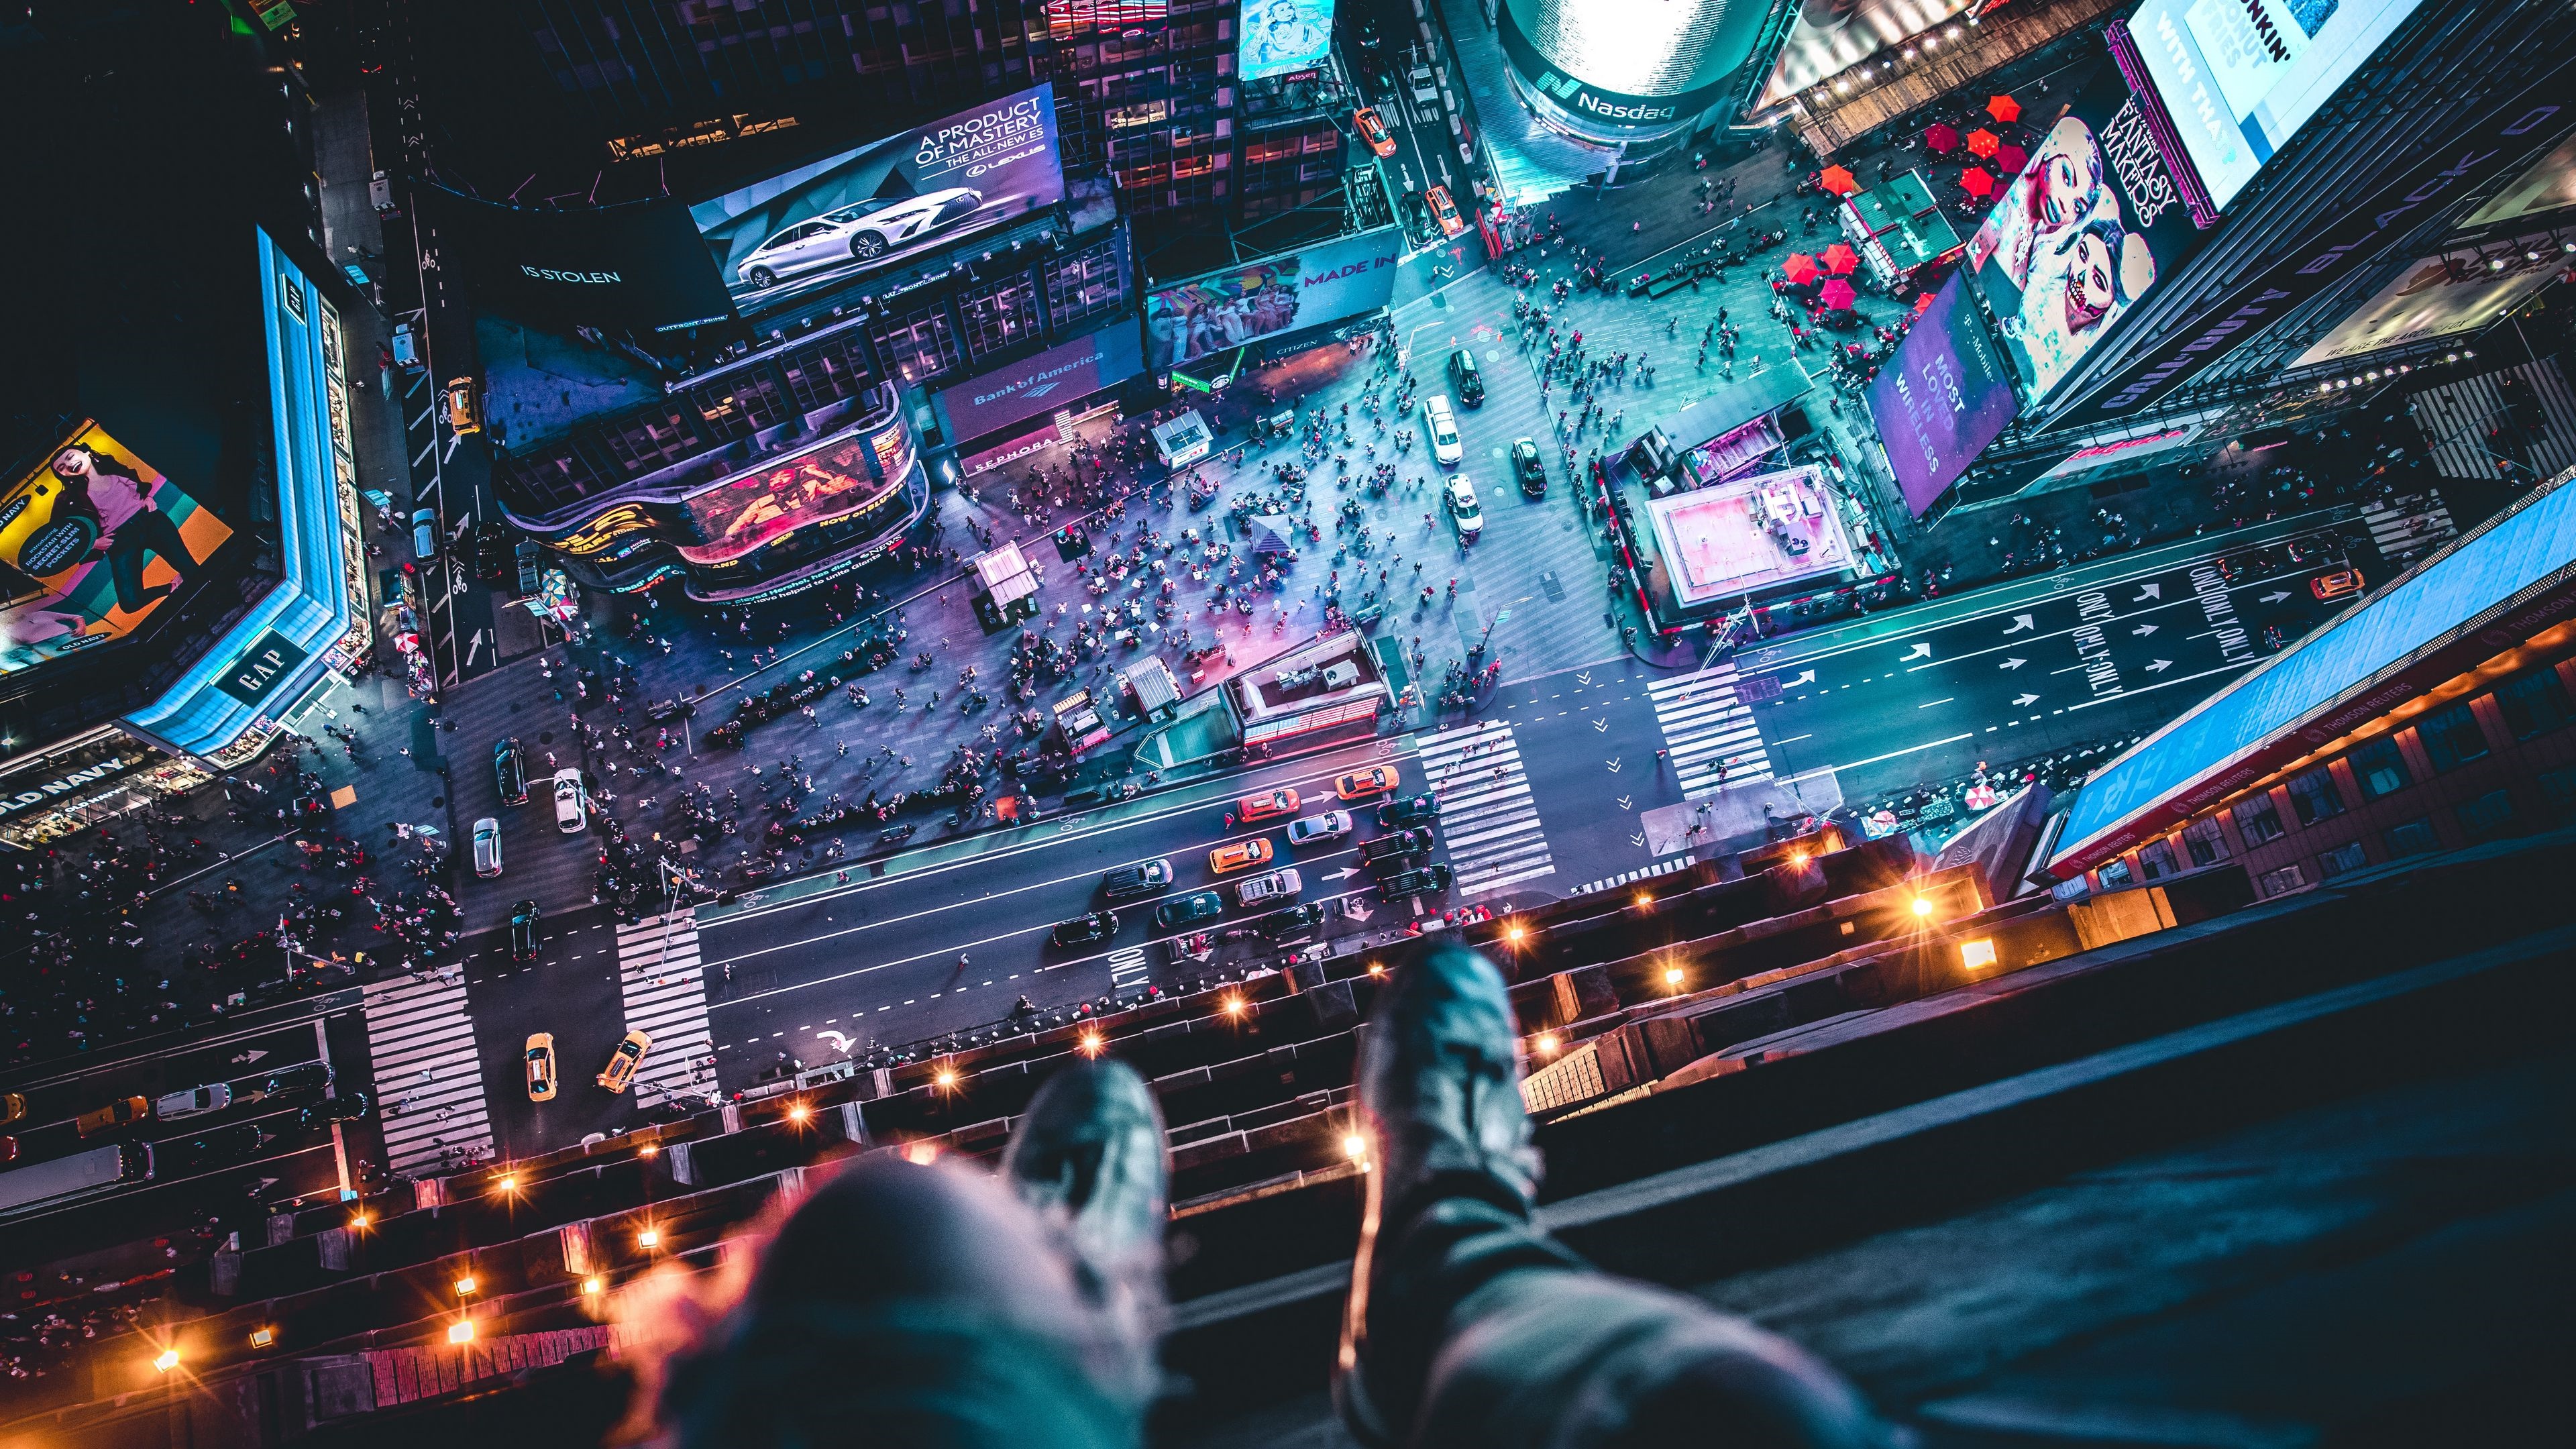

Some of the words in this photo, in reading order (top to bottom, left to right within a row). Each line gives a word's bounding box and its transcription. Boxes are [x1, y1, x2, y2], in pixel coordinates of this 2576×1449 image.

[2157, 10, 2196, 84] WITH
[2220, 0, 2268, 68] ONUT
[2241, 0, 2291, 63] NKIN'
[1288, 72, 1316, 81] Absen
[920, 136, 935, 150] A
[938, 97, 1040, 144] PRODUCT
[1578, 92, 1676, 120] Nasdaq
[915, 145, 944, 164] OF
[949, 111, 1041, 154] MASTERY
[946, 154, 970, 168] THE
[973, 133, 1026, 160] ALL-NEW
[1029, 127, 1044, 140] ES
[988, 144, 1046, 168] LEXUS
[2100, 117, 2158, 228] MAKERS
[2115, 99, 2178, 215] FANTASY
[521, 265, 540, 277] IS
[540, 269, 621, 282] STOLEN
[1304, 260, 1369, 288] MADE
[1374, 253, 1396, 269] IN
[2100, 357, 2195, 409] CALL
[2180, 288, 2292, 352] DUTY
[2295, 149, 2500, 274] BLACK
[1277, 339, 1318, 355] CITIZEN
[2325, 345, 2349, 358] WE
[2347, 340, 2375, 352] ARE
[2373, 334, 2401, 347] THE
[973, 384, 1016, 406] Bank
[1018, 375, 1035, 389] of
[1037, 352, 1104, 382] America
[1922, 362, 1954, 431] LOVED
[1935, 354, 1966, 413] MOST
[1921, 398, 1935, 423] IN
[975, 438, 1053, 472] SEPHORA
[5, 498, 25, 521] NAVY
[820, 514, 850, 527] NOW
[852, 508, 866, 518] ON
[25, 536, 58, 567] ROCKSTAR
[56, 523, 74, 538] WITH
[29, 527, 58, 553] introducing
[33, 527, 80, 570] SECRET-SLIM
[46, 537, 80, 568] POCKETS
[869, 534, 902, 556] NEWS
[647, 565, 671, 582] actor
[735, 592, 768, 604] played
[811, 571, 830, 581] has
[830, 560, 853, 572] died
[712, 559, 739, 569] AND
[778, 582, 813, 598] helped
[825, 569, 850, 581] unite
[851, 553, 881, 570] Giants
[2189, 566, 2229, 595] ONLY
[2076, 592, 2115, 621] ONLY
[2200, 594, 2240, 627] ONLY
[62, 639, 81, 651] OLD
[81, 633, 106, 644] NAVY
[2072, 626, 2110, 661] ONLY
[2216, 627, 2255, 663] ONLY
[239, 649, 285, 691] GAP
[2086, 661, 2123, 697] ONLY
[2323, 704, 2369, 732] THOMSON
[2369, 682, 2414, 710] REUTERS
[40, 757, 124, 794] NAVY
[2187, 784, 2221, 806] THOMSON
[2222, 767, 2255, 789] REUTERS
[64, 801, 90, 812] OLD
[87, 788, 121, 804] NAVY
[2082, 845, 2108, 863] THOMSON
[2108, 833, 2136, 851] REUTERS
[1108, 949, 1150, 989] ONLY
